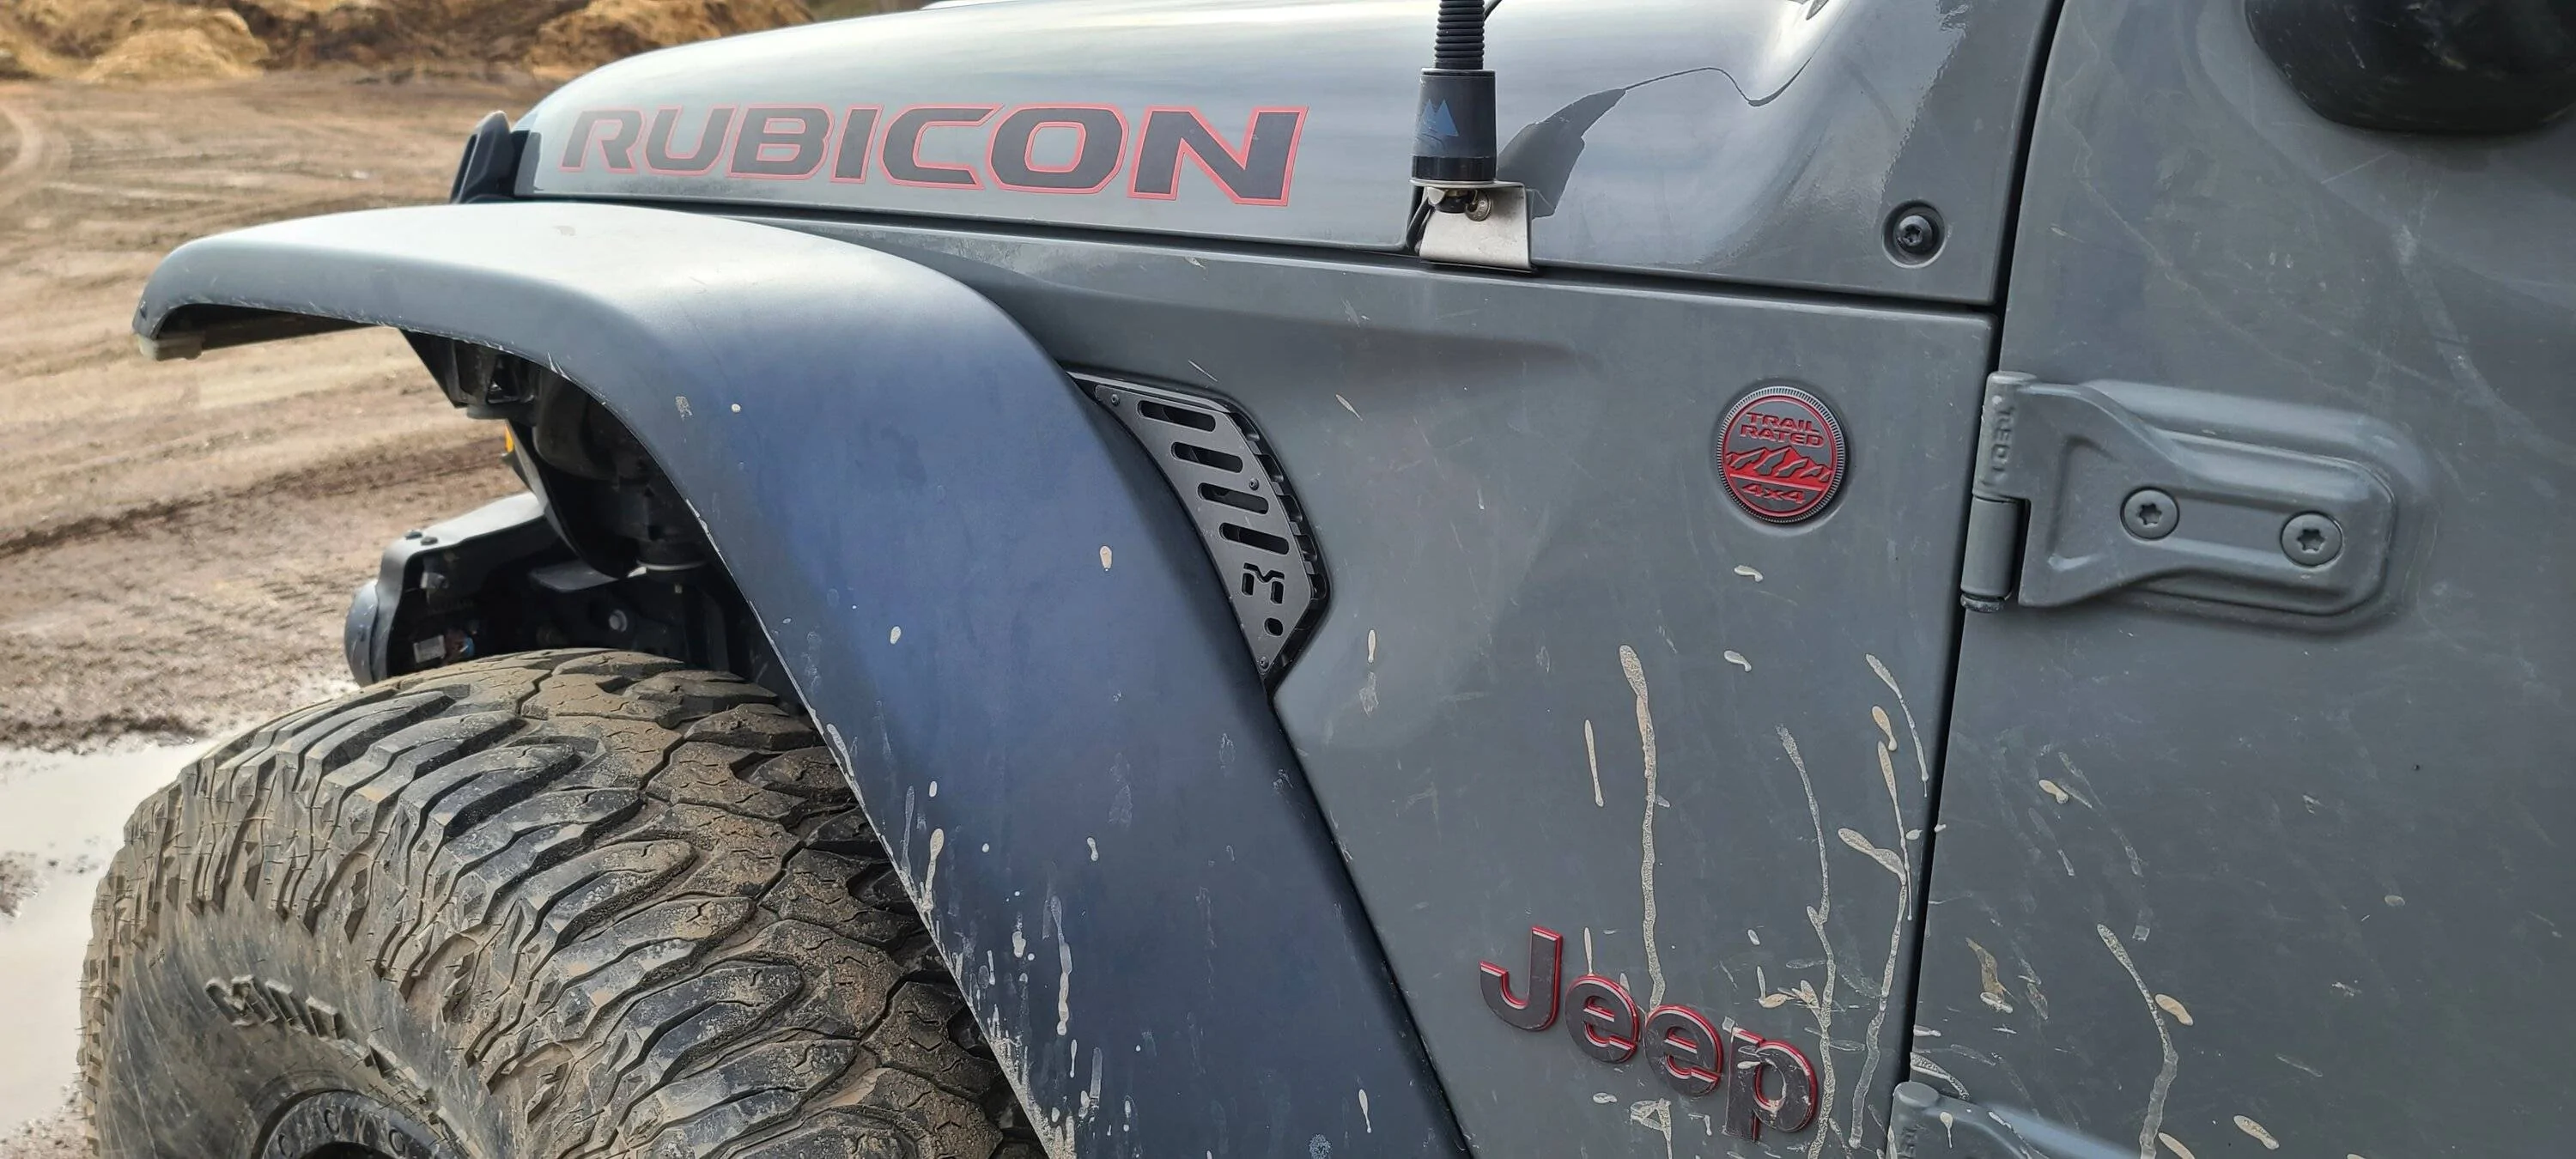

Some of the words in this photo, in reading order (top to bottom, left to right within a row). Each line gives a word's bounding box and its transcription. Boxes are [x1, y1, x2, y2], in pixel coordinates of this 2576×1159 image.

[559, 103, 1309, 207] RUBICON
[1740, 424, 1824, 447] RATED
[1746, 412, 1820, 434] TRAIL
[1479, 925, 1818, 1142] Jeep
